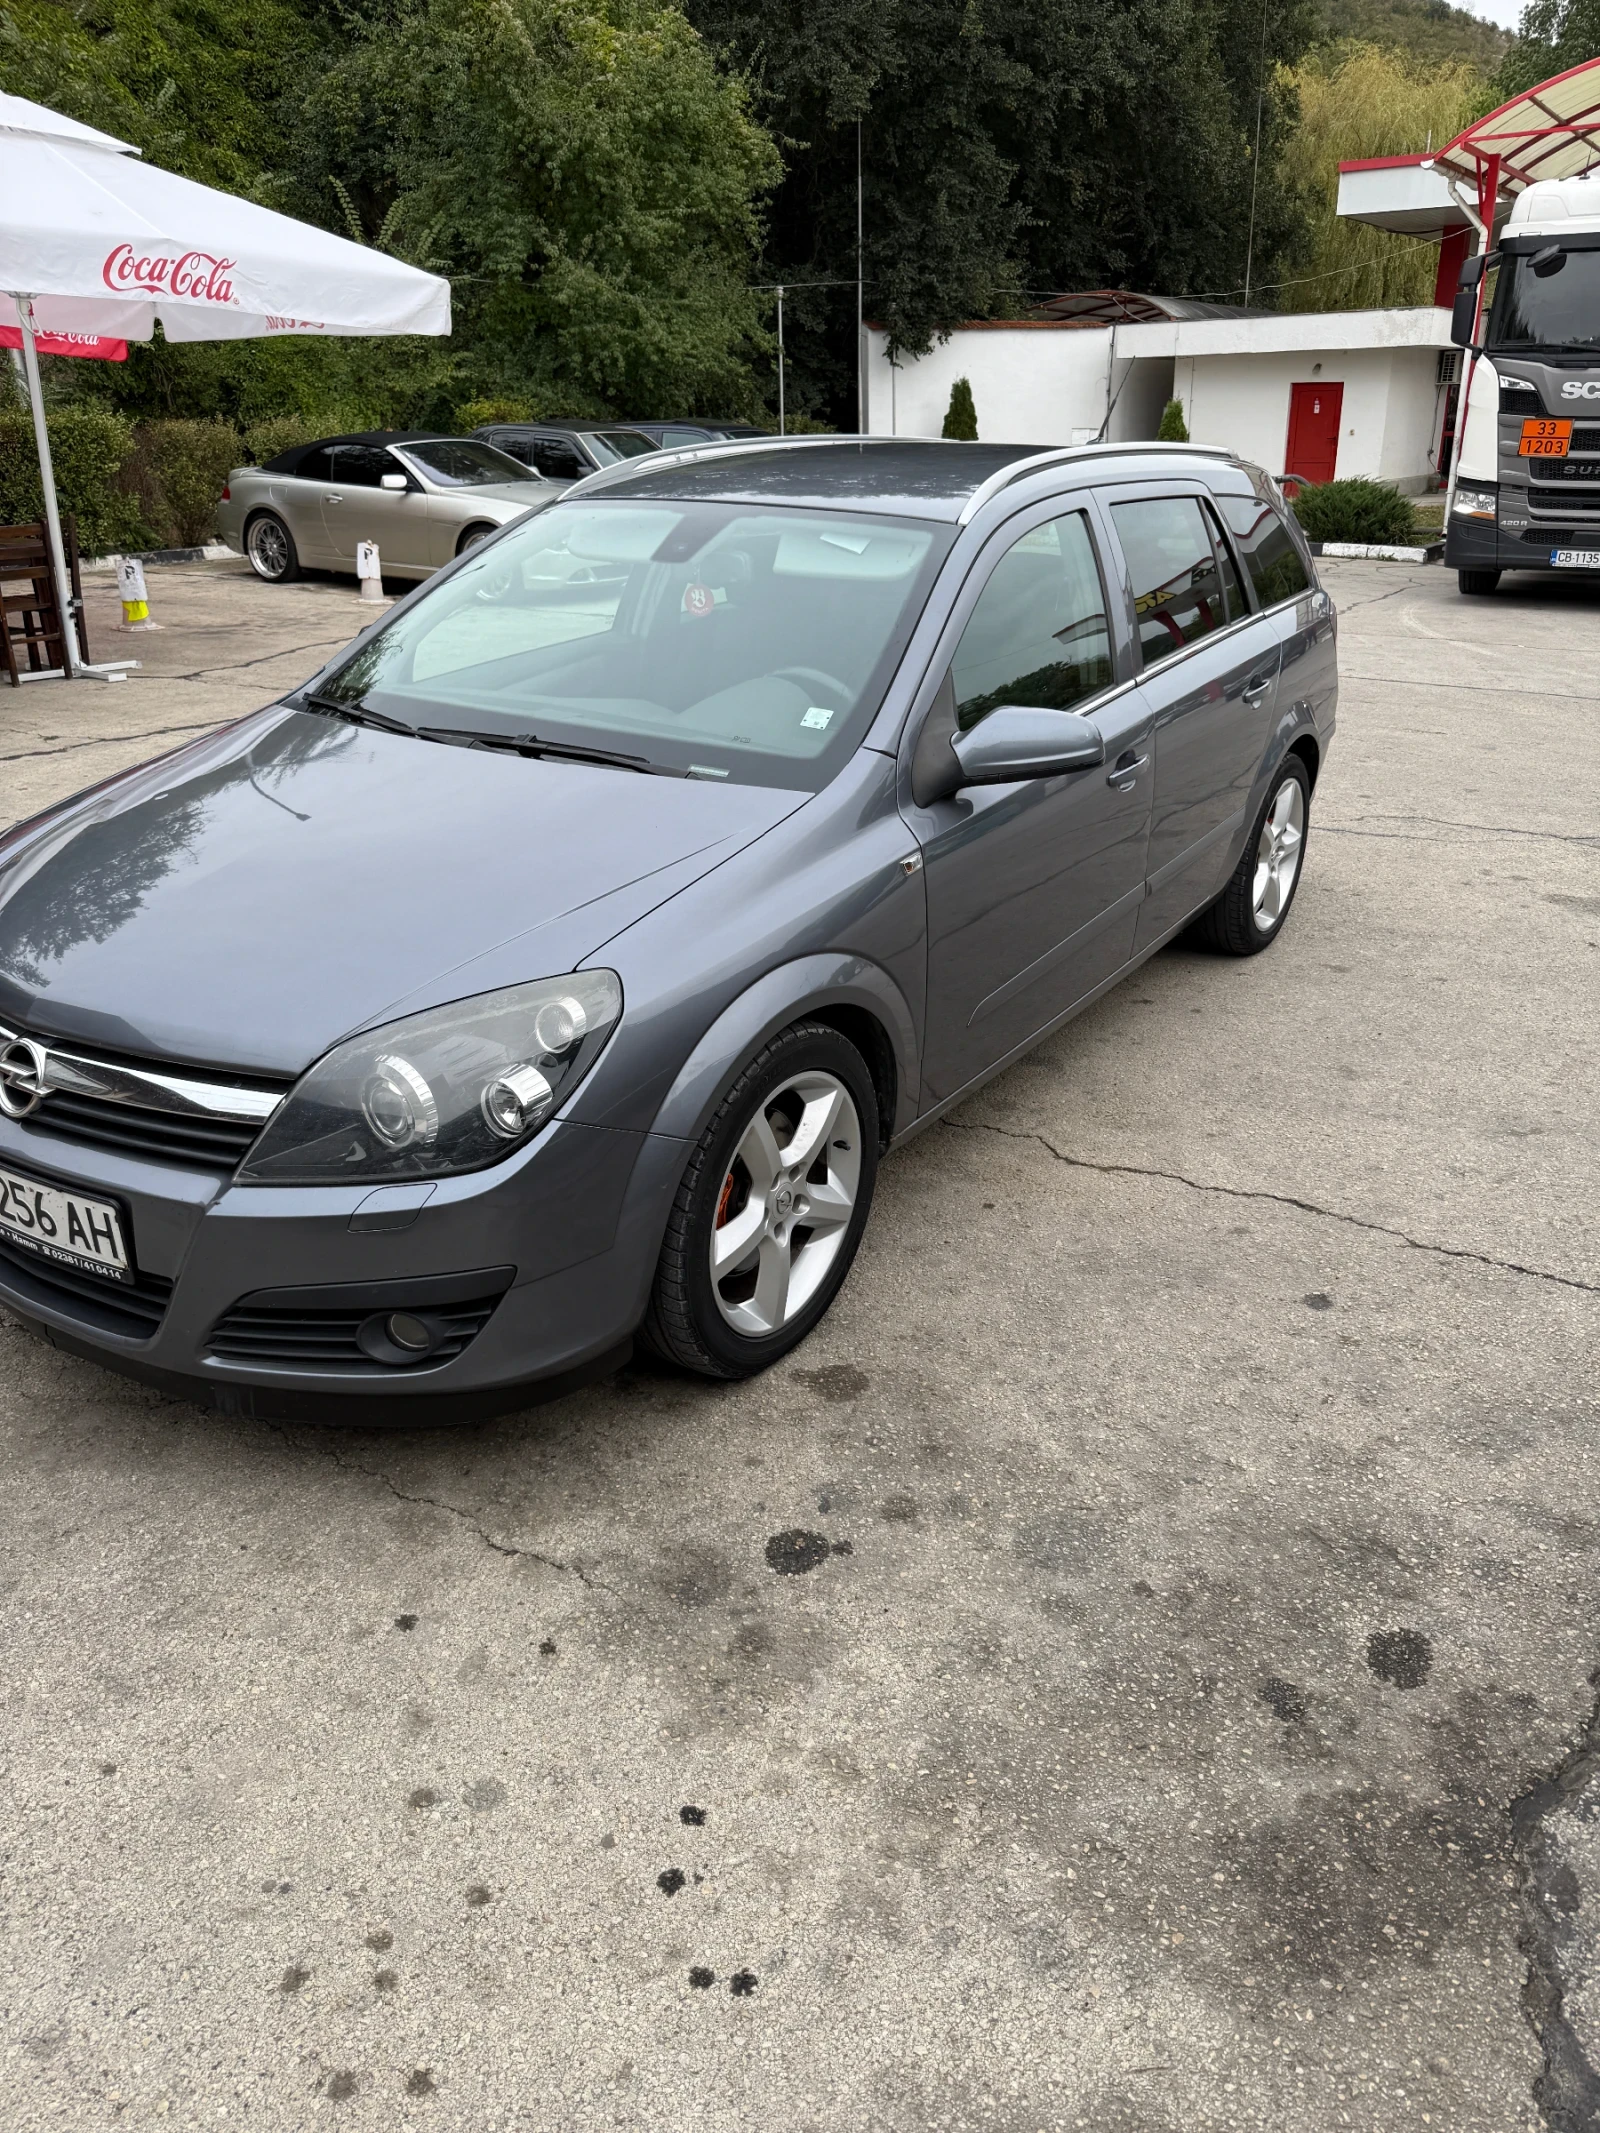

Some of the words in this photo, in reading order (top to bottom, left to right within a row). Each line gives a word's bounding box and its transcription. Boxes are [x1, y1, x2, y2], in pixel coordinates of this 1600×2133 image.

[102, 243, 237, 302] Coca-Cola
[1560, 381, 1600, 399] SC
[1537, 422, 1557, 435] 33
[1526, 440, 1563, 454] 1203
[67, 1201, 120, 1260] AH
[12, 1233, 38, 1251] Hamm
